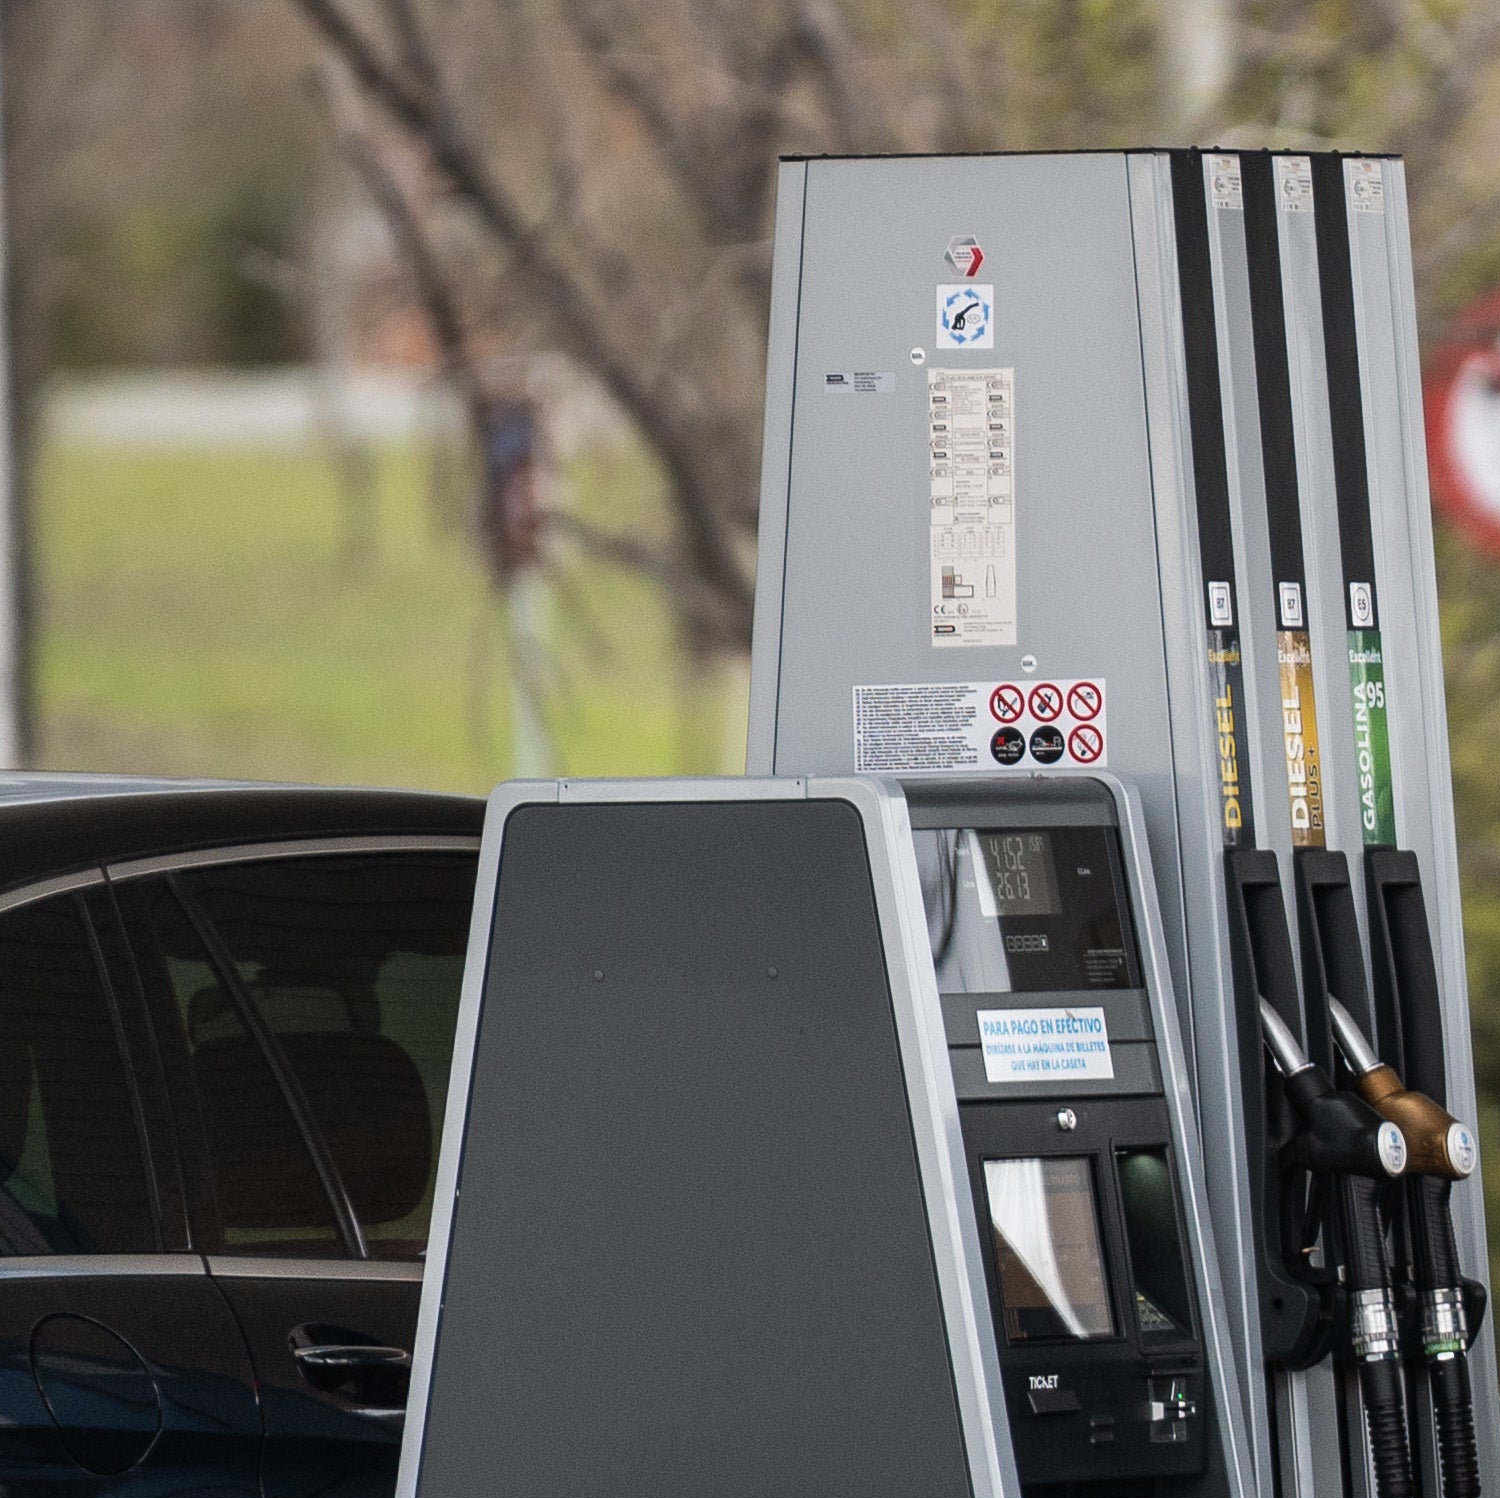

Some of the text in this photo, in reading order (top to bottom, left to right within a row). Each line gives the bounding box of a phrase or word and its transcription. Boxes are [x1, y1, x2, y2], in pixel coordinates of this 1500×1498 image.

[1278, 649, 1311, 664] Excellent
[1349, 649, 1382, 664] Excellent
[1366, 681, 1385, 709] 95
[1215, 683, 1242, 829] DIESEL
[1281, 684, 1310, 830] DIESEL
[1353, 681, 1376, 831] GASOLINA
[1308, 764, 1323, 830] PLUS
[983, 1016, 1102, 1036] PARA PAGO EN EFECTIVO
[1075, 1041, 1106, 1053] BILLETES
[1011, 1057, 1087, 1072] QUE HAY EN LA CASETA
[1029, 1374, 1059, 1390] TICKET
